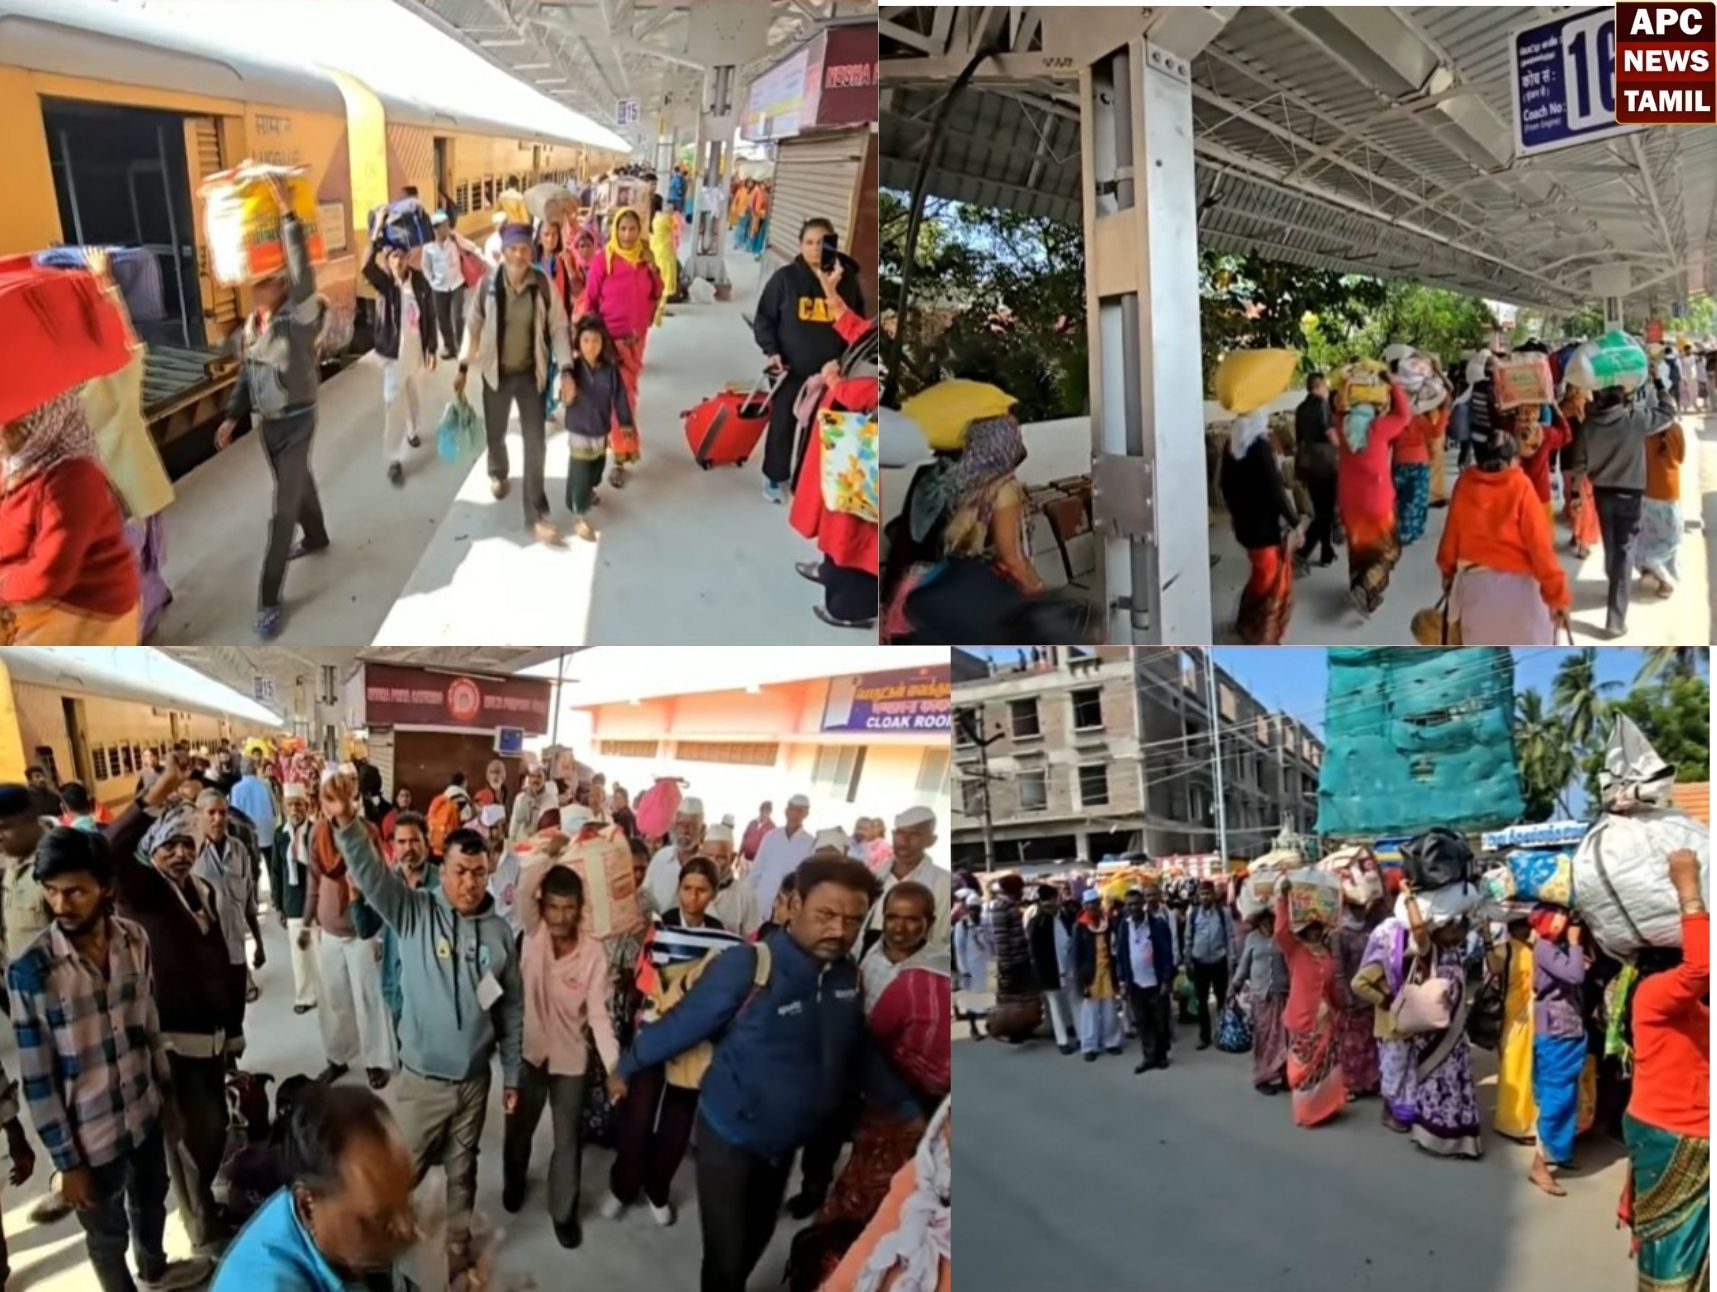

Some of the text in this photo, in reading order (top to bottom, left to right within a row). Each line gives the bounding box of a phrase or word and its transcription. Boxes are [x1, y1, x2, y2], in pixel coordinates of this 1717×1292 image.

[1523, 104, 1548, 122] Coach
[866, 714, 951, 729] CLOAK ROO
